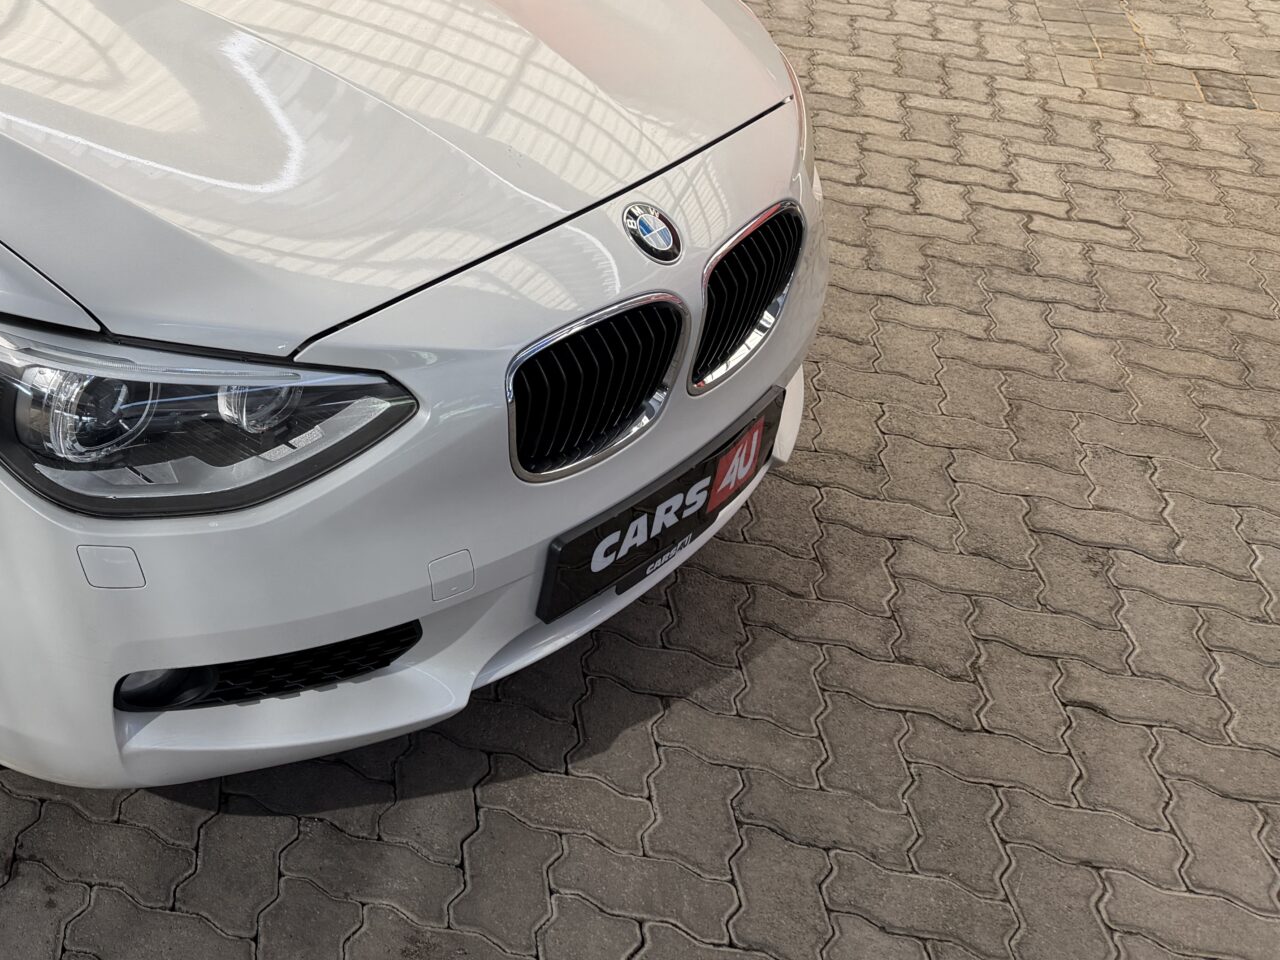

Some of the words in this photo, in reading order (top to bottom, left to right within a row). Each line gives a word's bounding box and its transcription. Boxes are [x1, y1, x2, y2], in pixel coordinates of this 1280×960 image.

[626, 205, 660, 230] BMW
[590, 475, 711, 573] CARS
[717, 430, 759, 493] 4U
